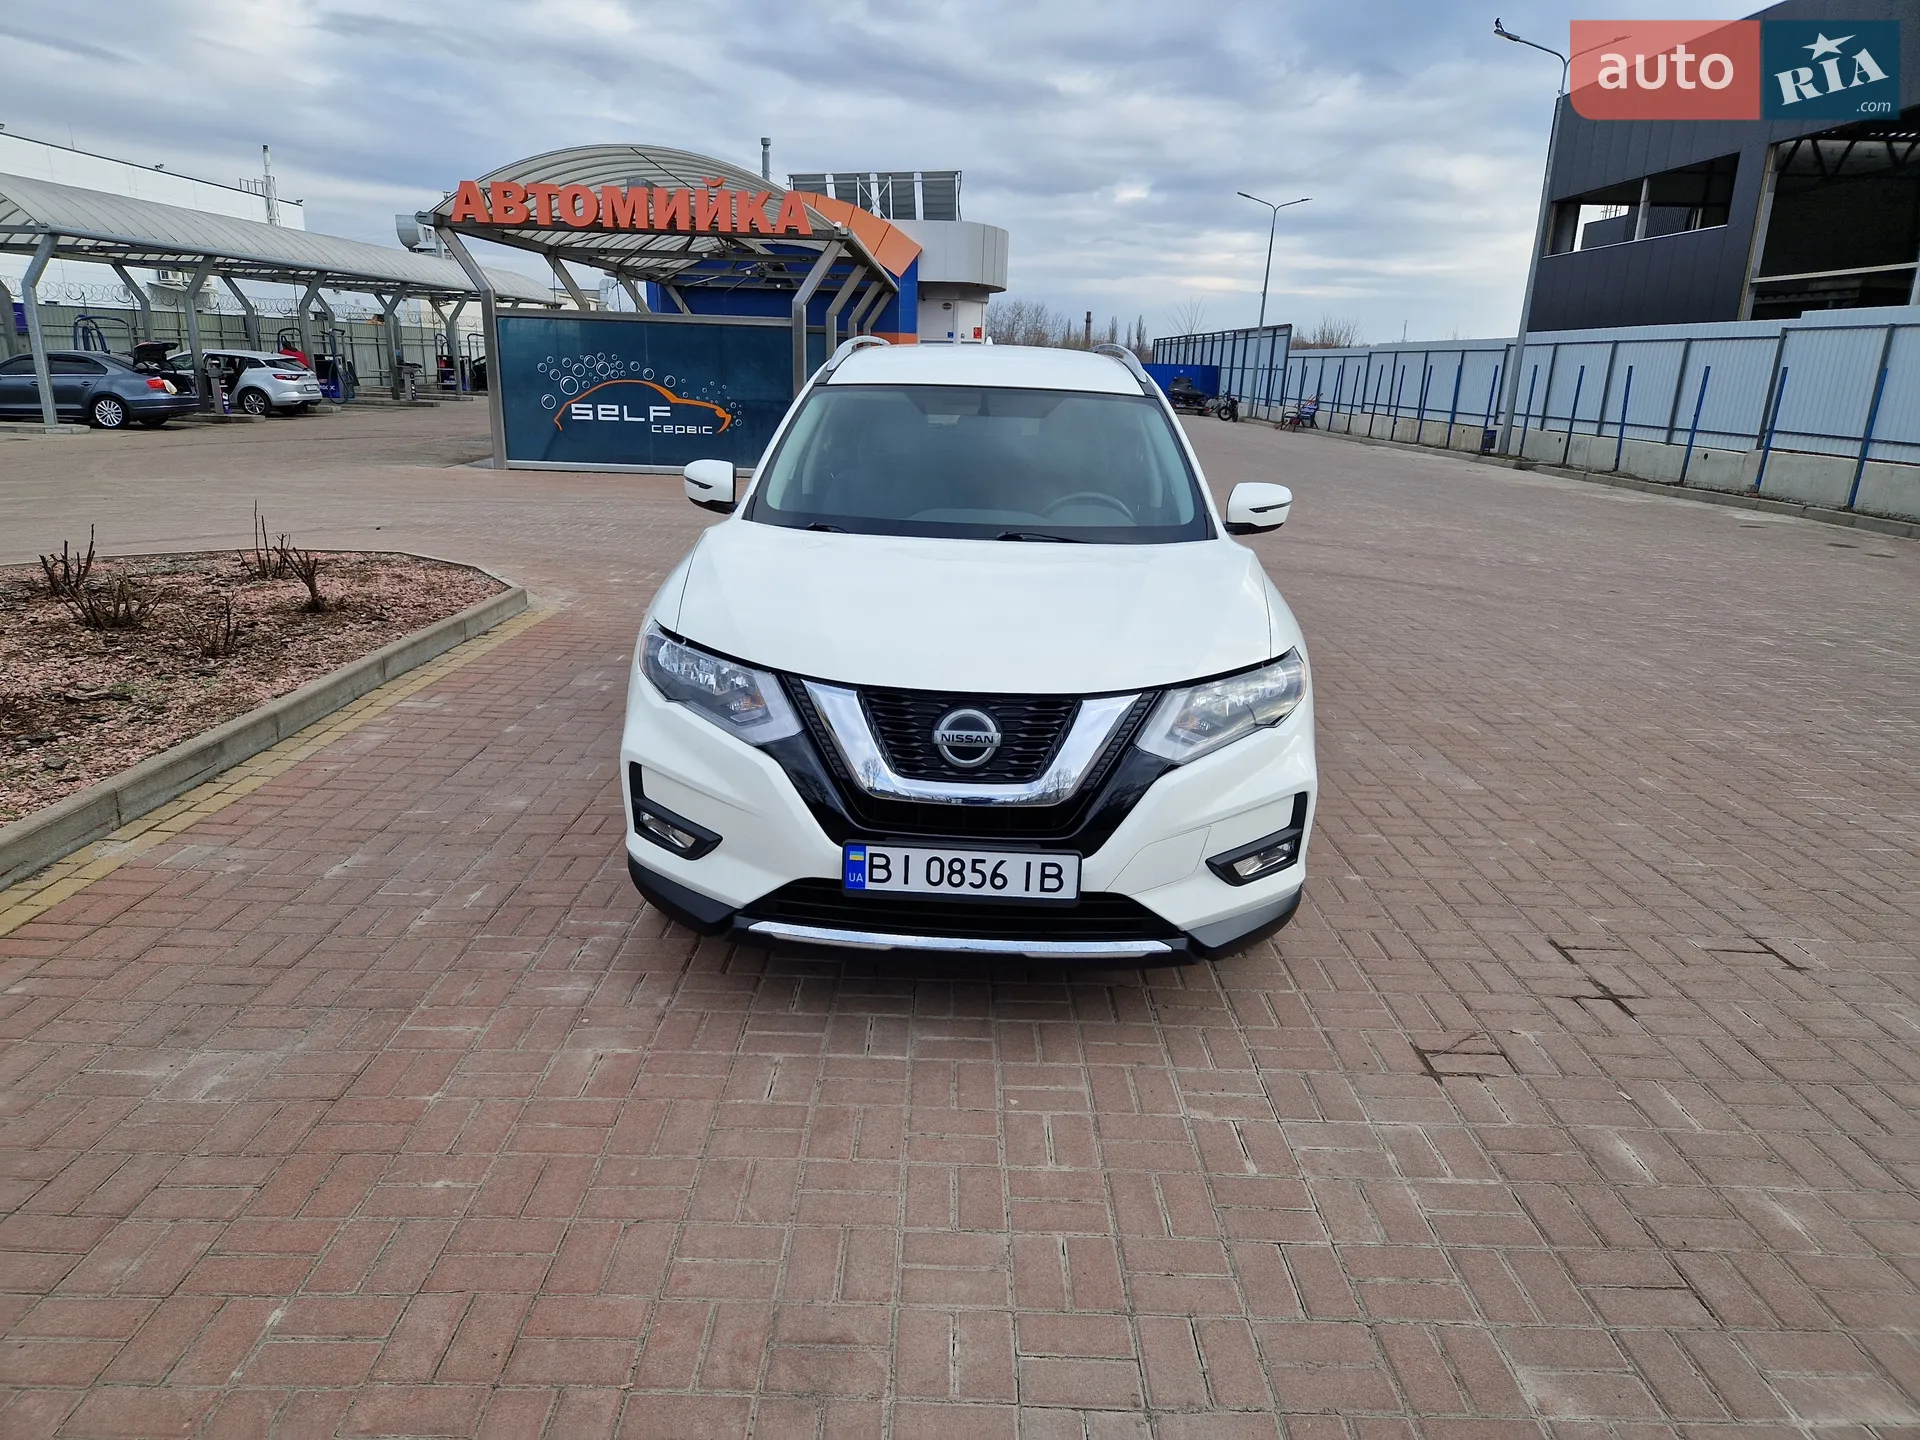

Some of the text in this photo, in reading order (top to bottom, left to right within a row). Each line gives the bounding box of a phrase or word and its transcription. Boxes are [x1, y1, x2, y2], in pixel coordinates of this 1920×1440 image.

[450, 176, 814, 236] АВТОМИЙКА
[941, 733, 994, 744] NISSAN
[849, 873, 864, 882] UA
[868, 852, 1064, 893] BI 0856 IB
